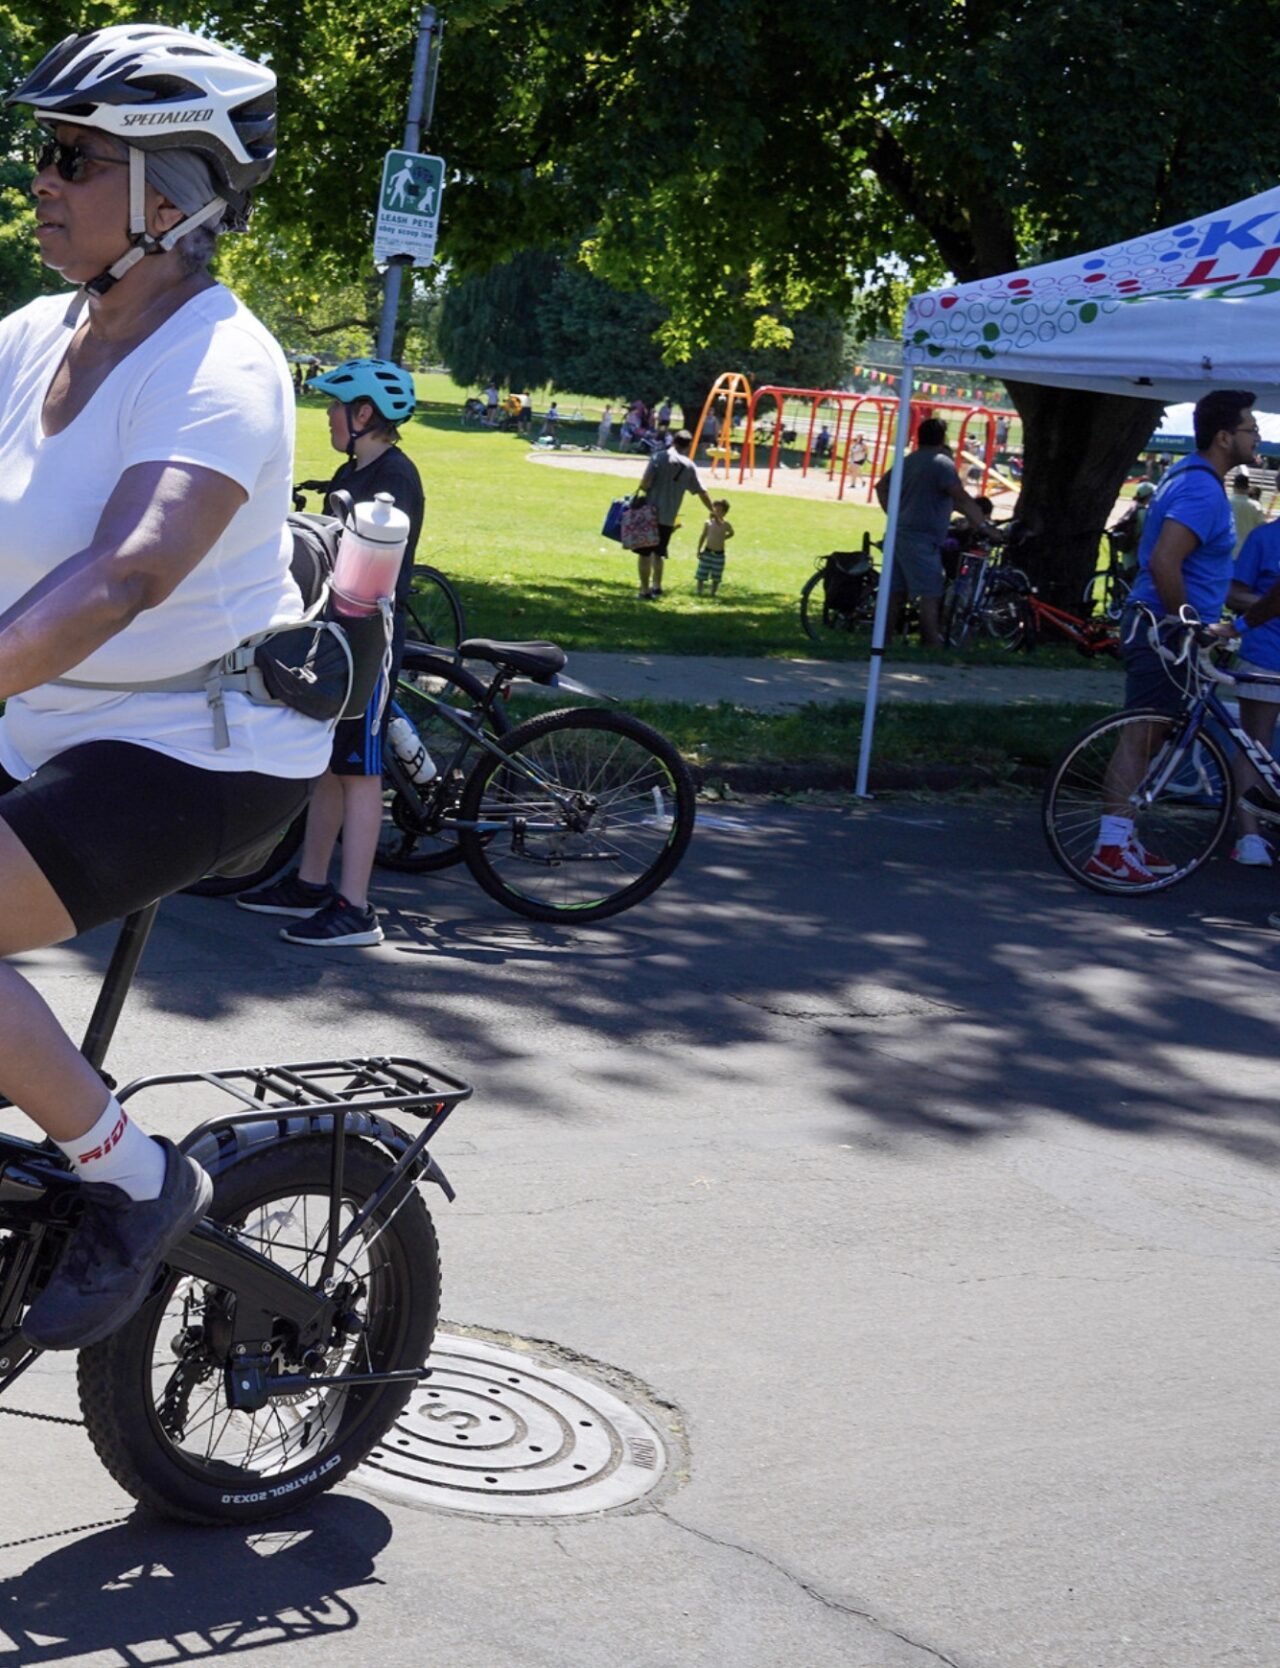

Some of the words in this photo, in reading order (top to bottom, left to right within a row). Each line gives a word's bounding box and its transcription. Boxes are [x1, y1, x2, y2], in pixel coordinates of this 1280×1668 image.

[120, 109, 214, 127] SPECIALIZED
[380, 213, 408, 225] LEASH
[412, 218, 434, 229] PETS
[1195, 211, 1280, 258] K
[319, 1454, 341, 1476] CST
[268, 1470, 318, 1497] PATROL
[222, 1491, 267, 1503] 20X3.0
